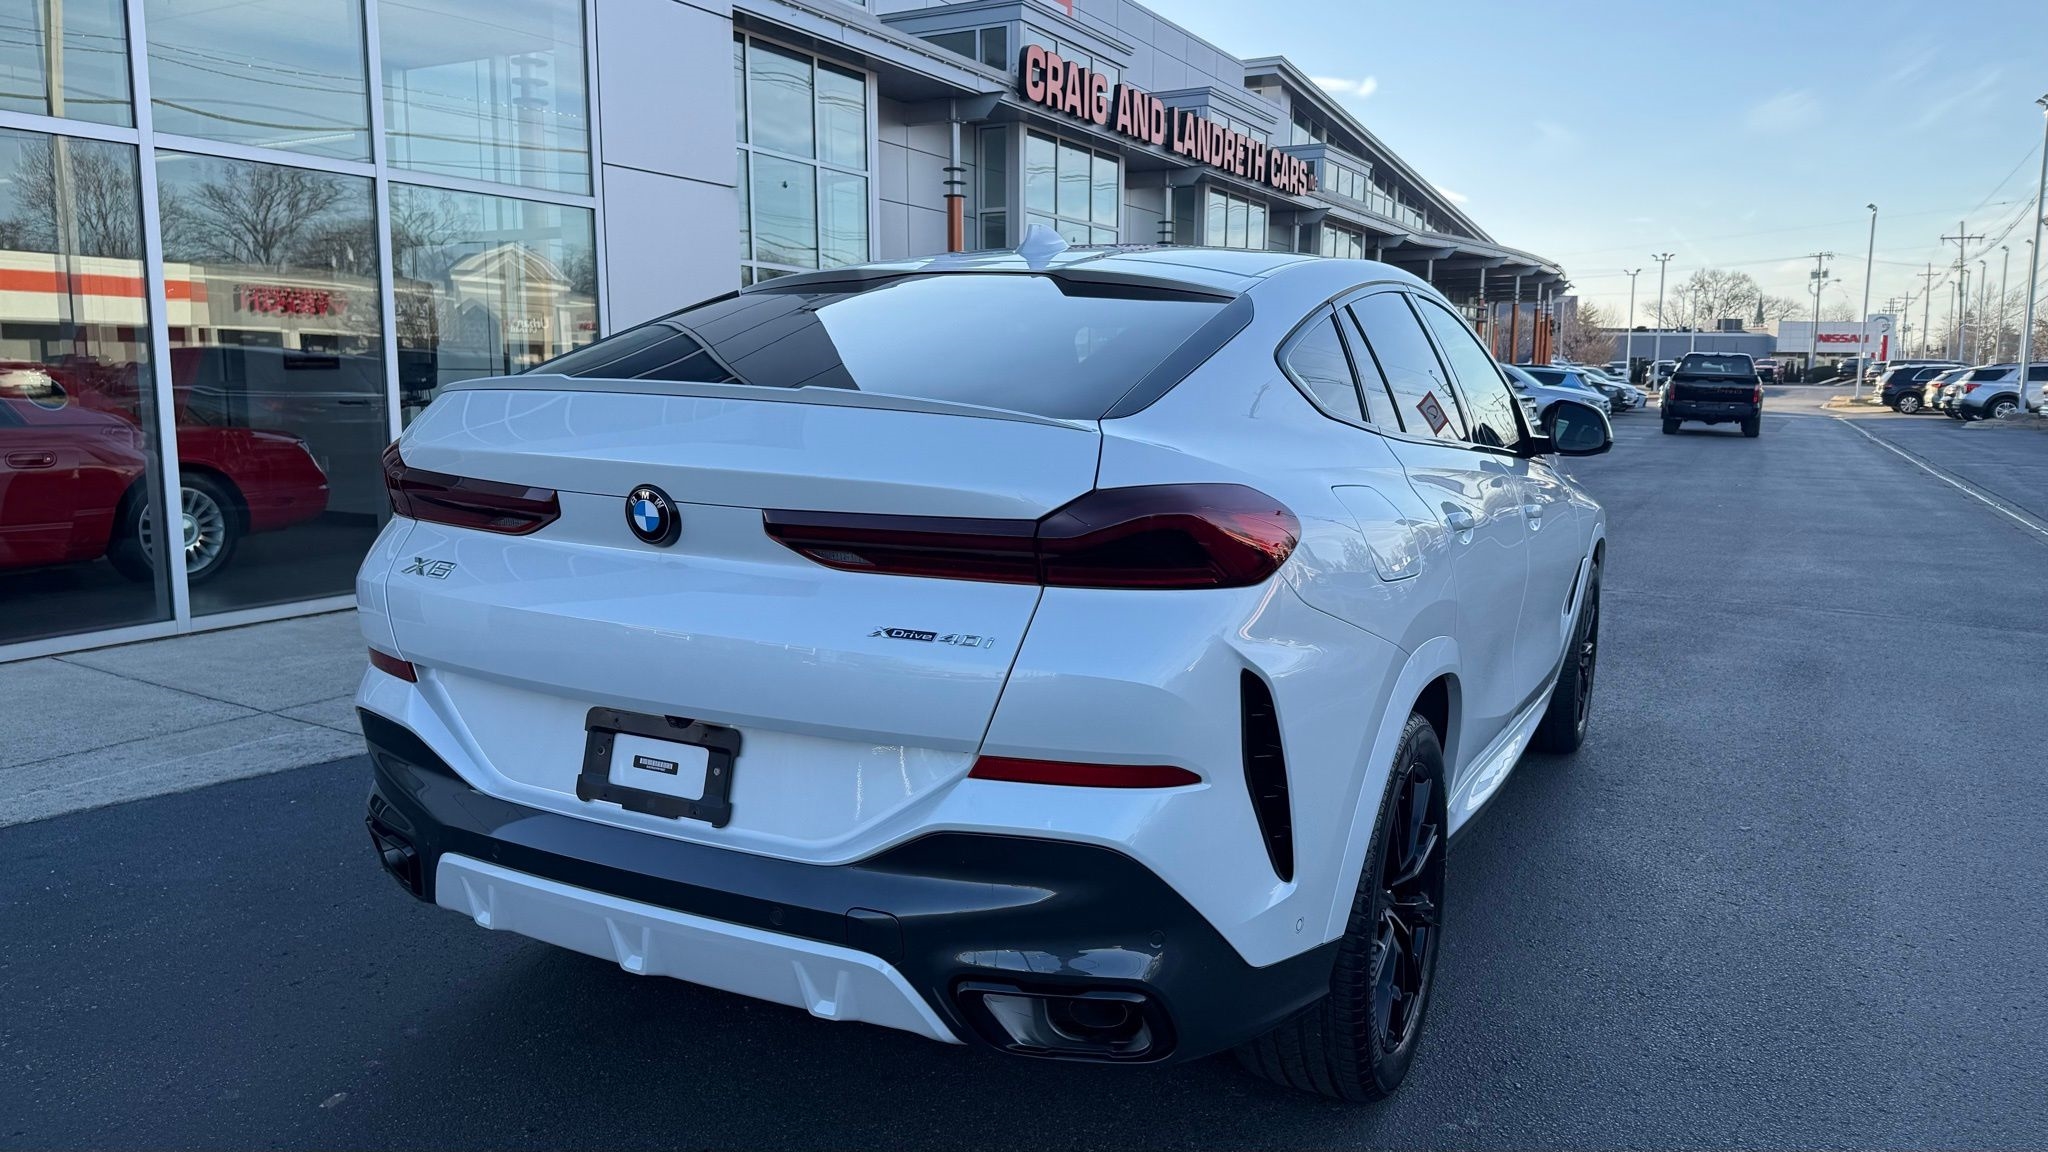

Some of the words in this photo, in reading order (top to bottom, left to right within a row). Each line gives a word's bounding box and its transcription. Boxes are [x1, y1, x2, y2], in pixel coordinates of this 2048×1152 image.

[1025, 44, 1108, 125] CRAIG
[1115, 83, 1165, 146] AND
[1172, 106, 1266, 183] LANDRETH
[1270, 147, 1308, 197] CARS
[630, 490, 665, 509] BMW
[401, 556, 458, 580] X6
